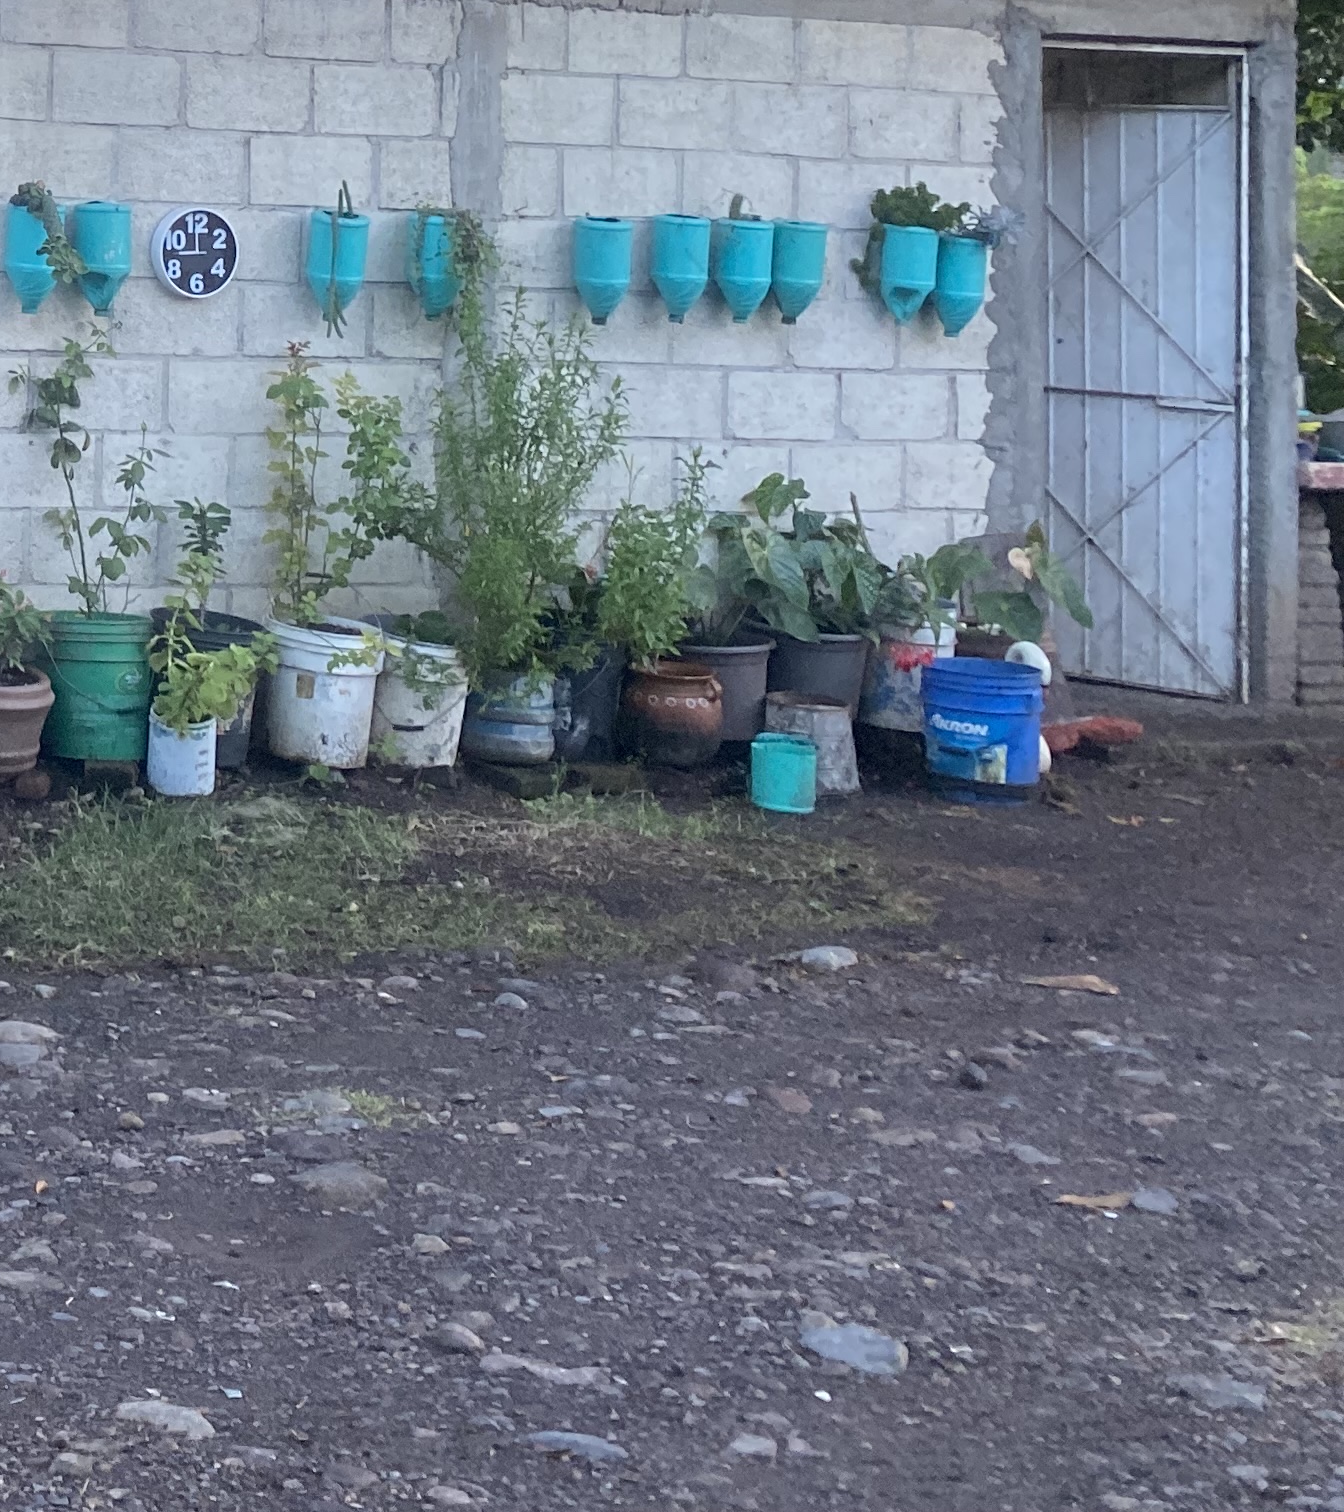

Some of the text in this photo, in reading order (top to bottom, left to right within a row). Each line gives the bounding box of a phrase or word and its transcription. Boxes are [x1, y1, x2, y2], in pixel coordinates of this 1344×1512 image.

[185, 213, 209, 234] 12
[165, 229, 187, 251] 10
[212, 228, 227, 249] 2
[167, 259, 182, 279] 8
[210, 257, 226, 278] 4
[189, 273, 204, 293] 6
